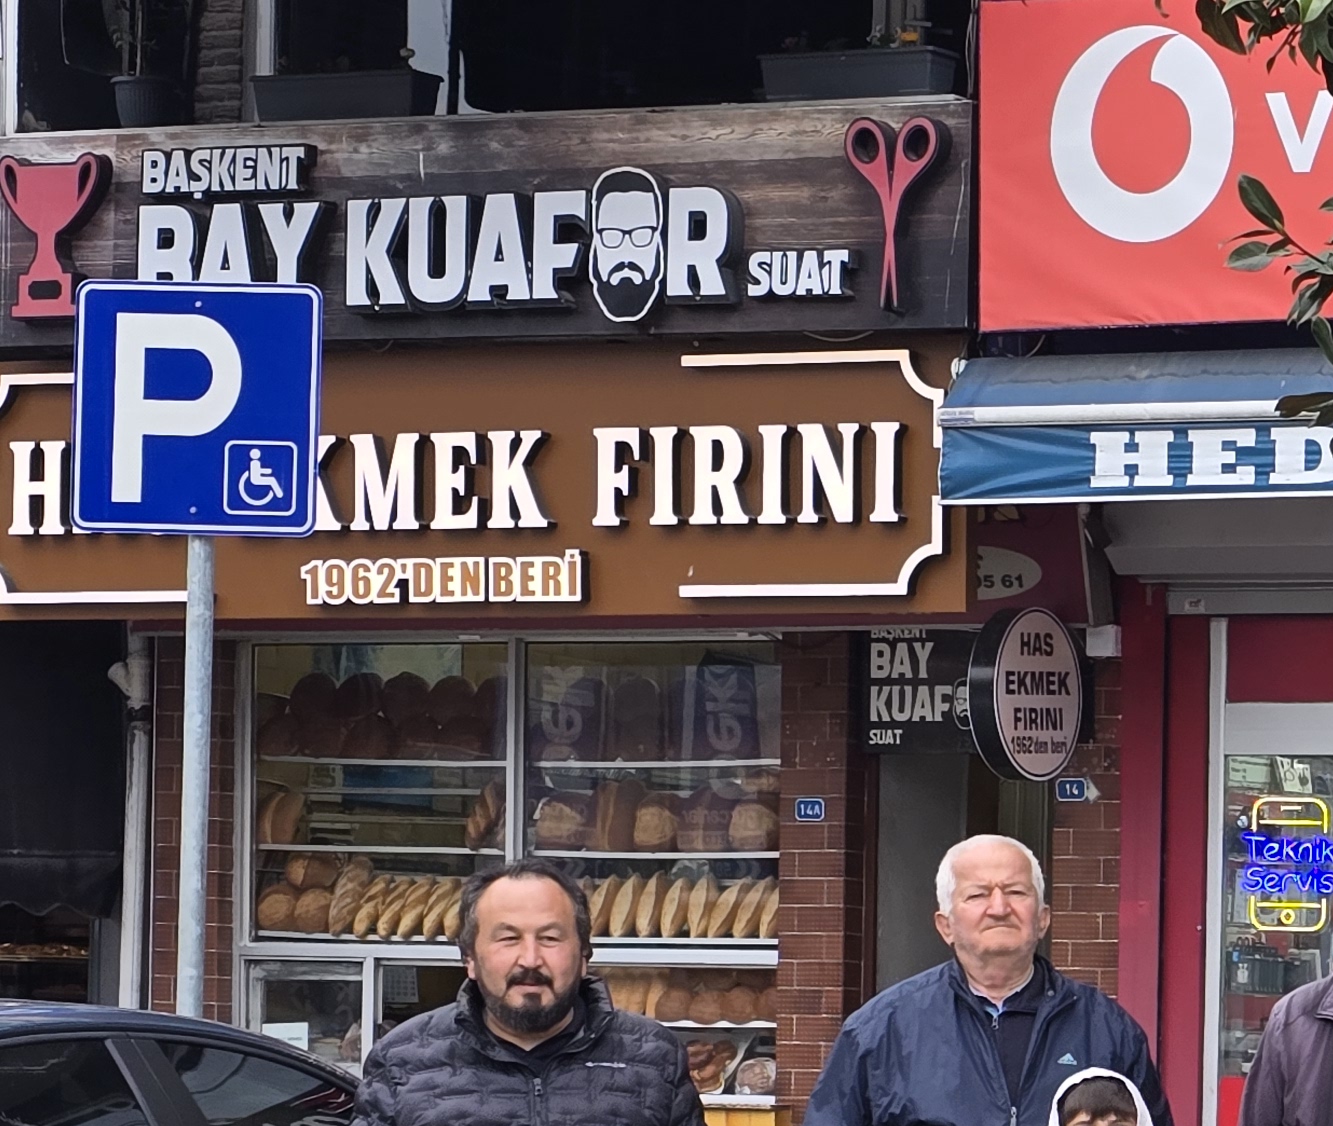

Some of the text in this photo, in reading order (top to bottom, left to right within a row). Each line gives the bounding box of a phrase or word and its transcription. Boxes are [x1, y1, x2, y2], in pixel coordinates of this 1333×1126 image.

[142, 146, 306, 196] BAŞKENT
[748, 250, 850, 297] SUAT
[111, 312, 243, 504] P
[593, 422, 905, 527] FIRINI
[302, 549, 585, 606] 1962'DEN BERİ
[1001, 573, 1024, 589] 61
[1020, 632, 1054, 656] HAS
[870, 642, 934, 679] BAY
[1005, 671, 1071, 696] EKMEK
[1013, 707, 1063, 731] FIRINI
[869, 729, 903, 744] SUAT
[1065, 784, 1078, 796] 14
[800, 803, 821, 816] 14A
